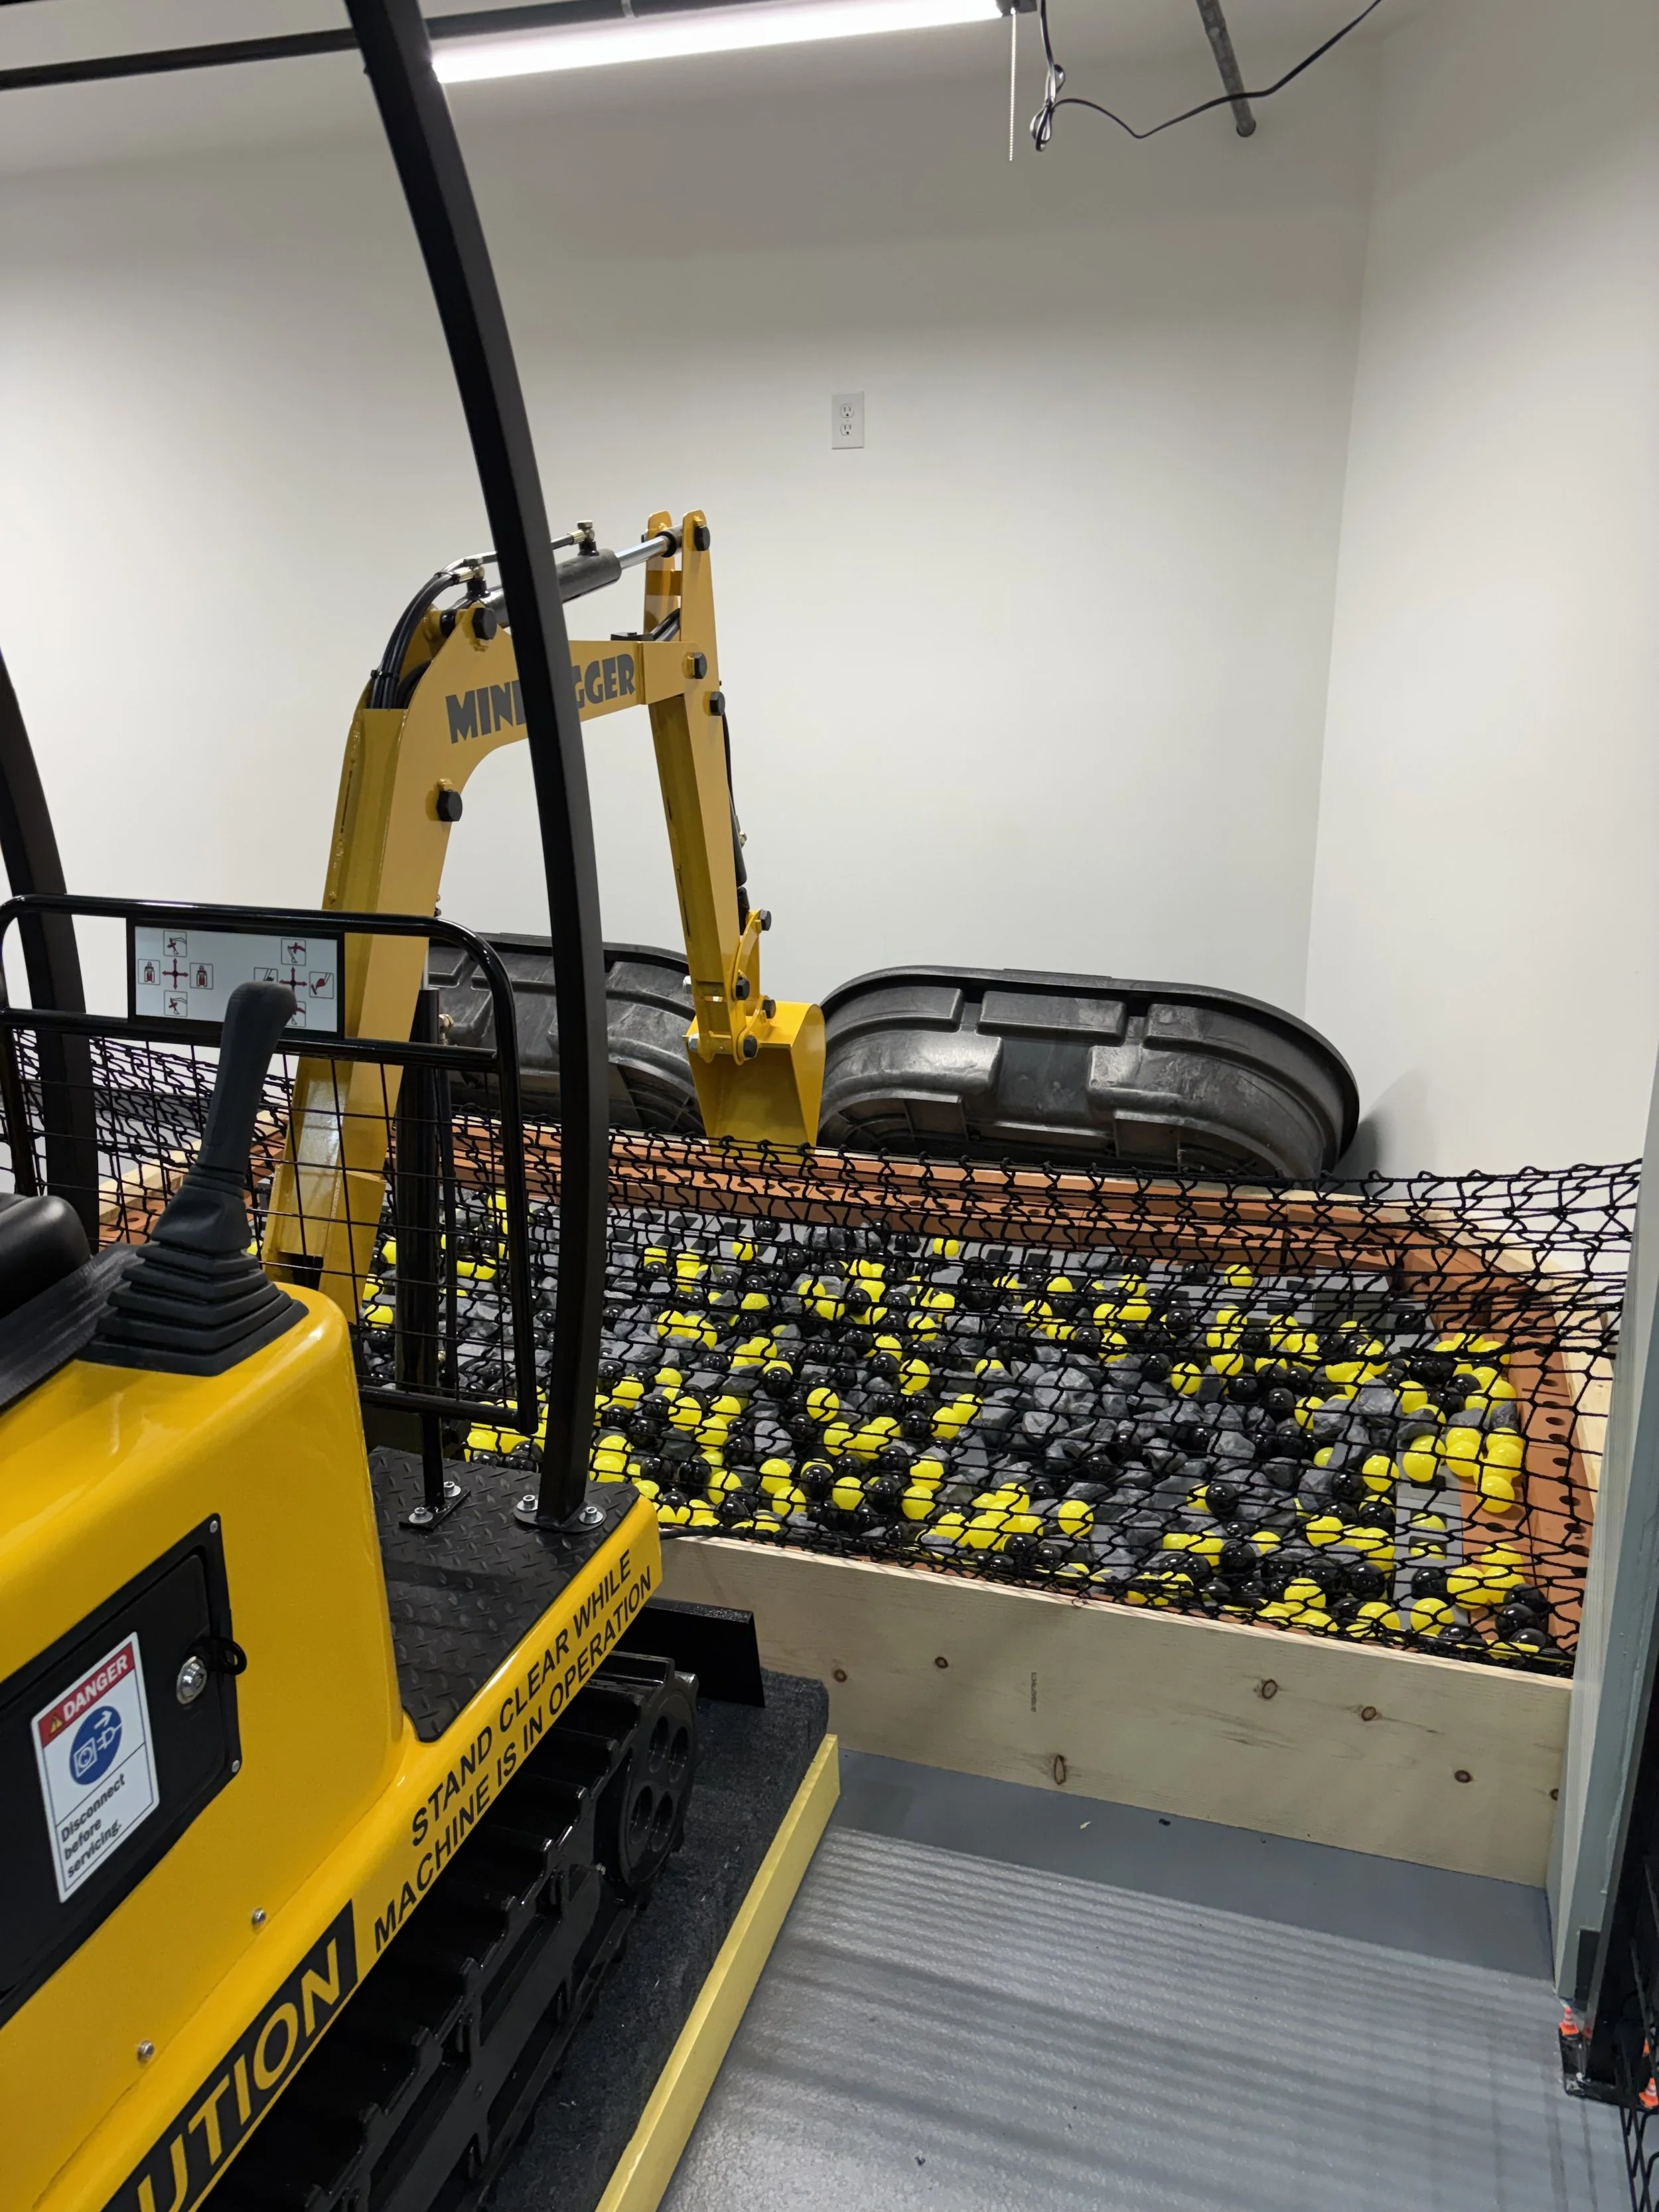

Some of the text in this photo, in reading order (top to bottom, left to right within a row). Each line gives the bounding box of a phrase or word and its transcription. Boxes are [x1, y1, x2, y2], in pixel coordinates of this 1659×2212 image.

[63, 1655, 128, 1721] DANGER
[412, 1548, 630, 1846] STAND CLEAR WHILE
[374, 1565, 651, 1953] MACHINE IS IN OPERATION
[61, 1773, 125, 1843] Disconnect
[64, 1818, 102, 1861] before
[68, 1819, 121, 1878] servicing.
